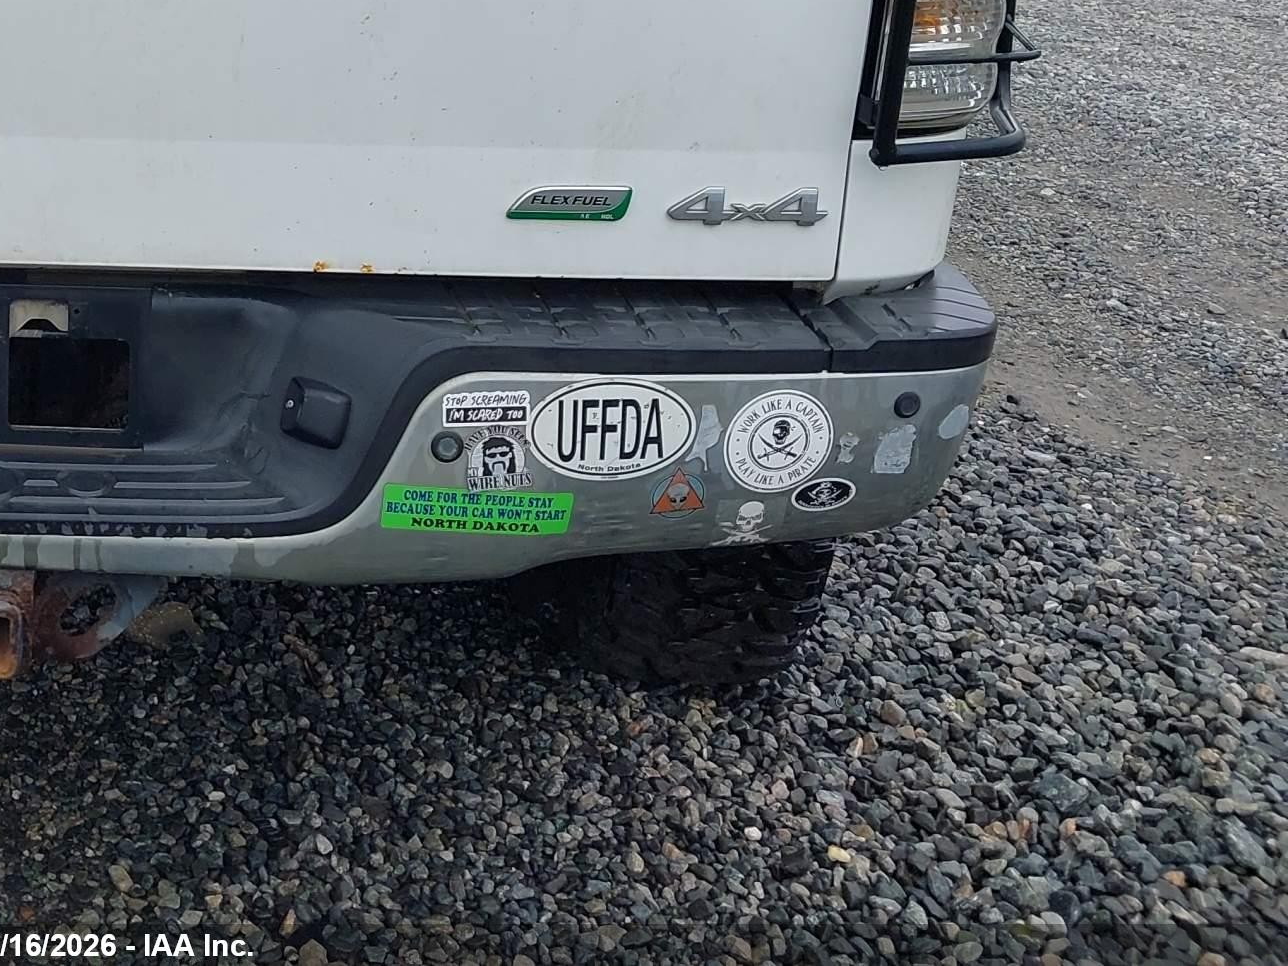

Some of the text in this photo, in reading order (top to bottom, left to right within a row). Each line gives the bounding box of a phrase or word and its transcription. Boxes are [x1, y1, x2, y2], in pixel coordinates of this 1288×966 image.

[531, 195, 612, 206] FLEX FUEL
[666, 185, 829, 226] 4x4
[445, 394, 527, 407] STOP SCREAMING
[448, 408, 523, 421] I'M SCARED TOO
[737, 399, 825, 434] WORK LIKE A CAPTAIN
[557, 398, 664, 462] UFFDA
[577, 463, 641, 472] North Dakota
[736, 456, 816, 485] PLAY LIKE A PIRATE
[468, 473, 532, 490] WIRE NUTS
[404, 489, 554, 508] COME FOR THE PEOPLE STAY
[386, 501, 567, 522] BECAUSE YOUR CAR WON'T START
[411, 517, 540, 532] NORTH DAKOTA
